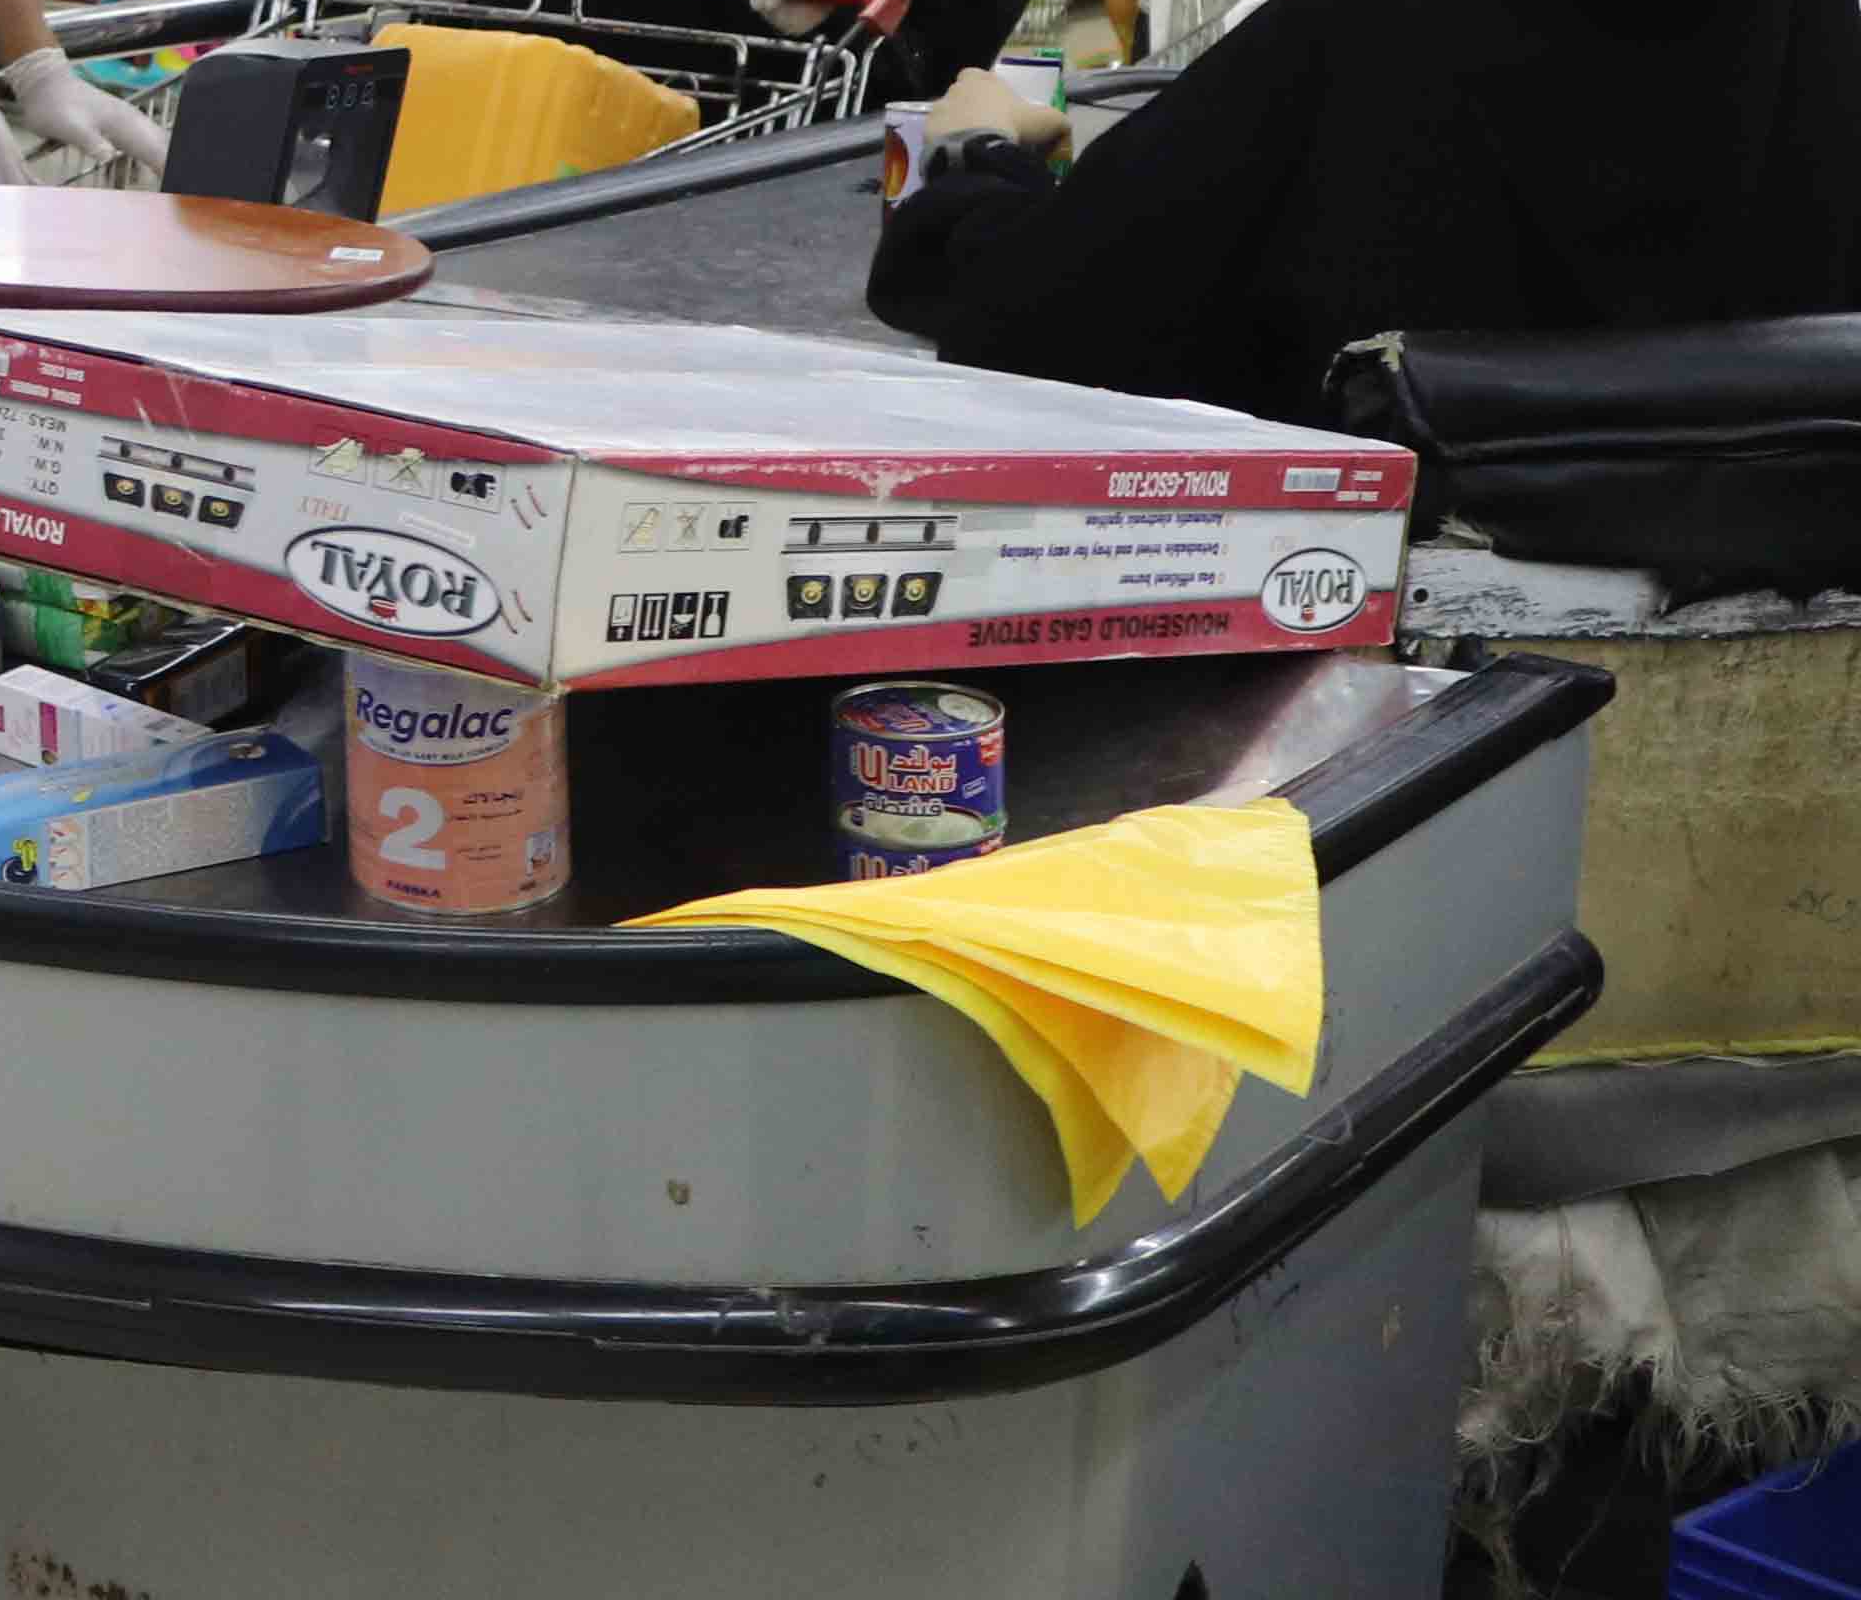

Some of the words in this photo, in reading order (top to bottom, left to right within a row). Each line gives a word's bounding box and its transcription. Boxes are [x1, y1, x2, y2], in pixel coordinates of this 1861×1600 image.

[310, 538, 479, 620] ROYAL
[1274, 568, 1356, 608] ROYAL
[968, 620, 1041, 648] STOVE
[1048, 617, 1093, 643] GAS
[1102, 610, 1231, 643] HOUSEHOLD
[356, 687, 513, 744] Regalac
[378, 786, 446, 871] 2
